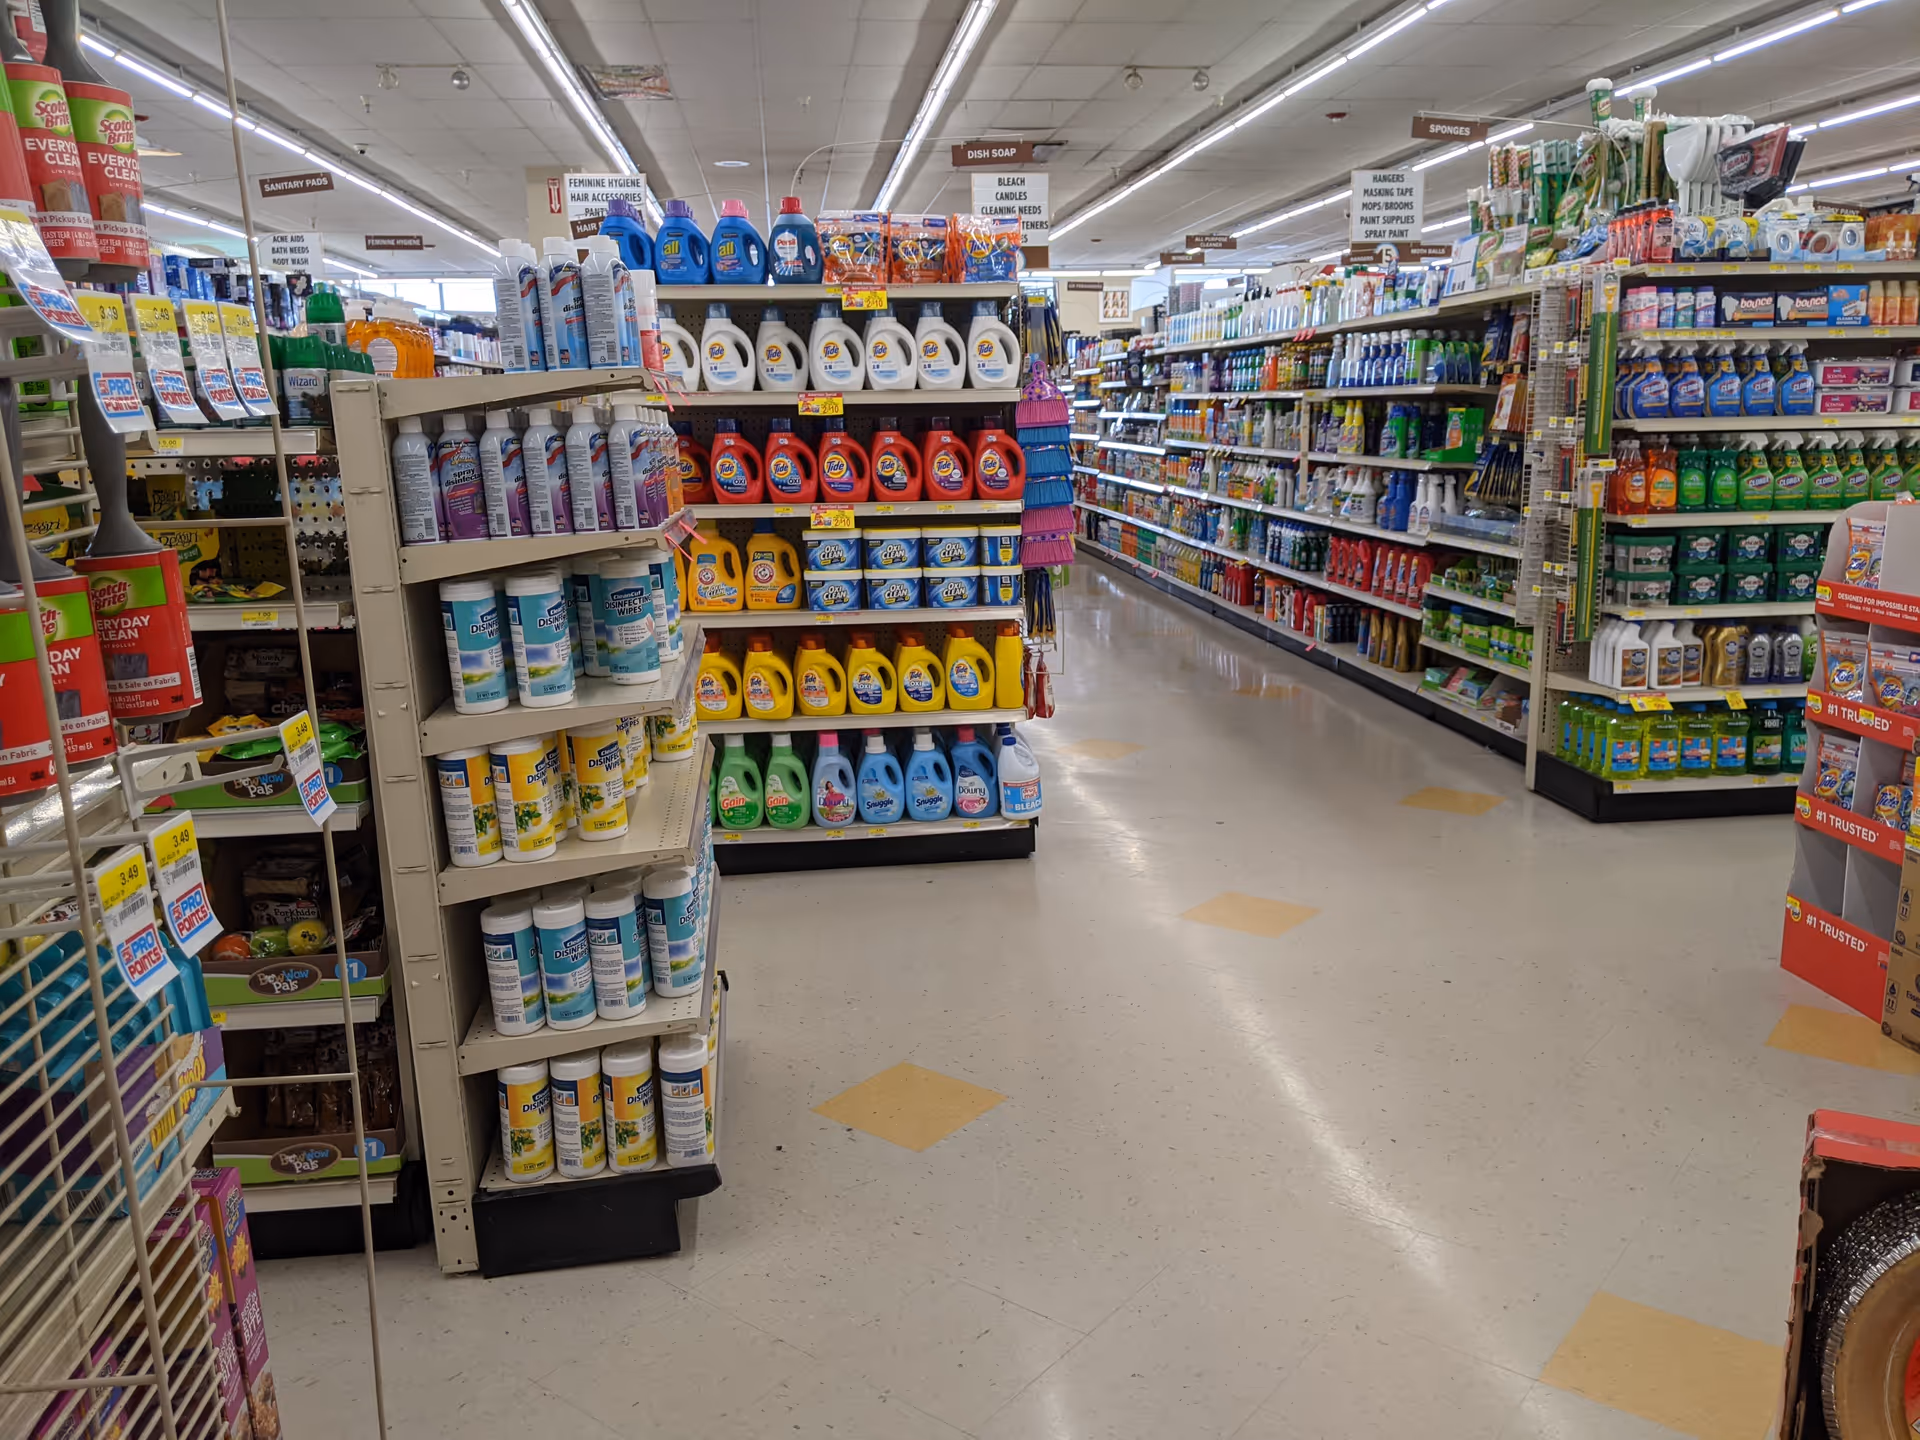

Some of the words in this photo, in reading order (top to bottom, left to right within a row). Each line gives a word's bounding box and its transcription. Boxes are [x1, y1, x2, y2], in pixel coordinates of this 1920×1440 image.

[1429, 123, 1470, 136] SPONGES
[967, 149, 988, 159] DISH
[991, 148, 1016, 158] SOAP
[264, 179, 303, 192] SANITARY
[305, 177, 328, 188] PADS
[569, 178, 606, 187] FEMININE
[608, 178, 640, 187] HYGIENE
[998, 178, 1025, 186] BLEACH
[1372, 174, 1404, 184] HANGERS
[571, 193, 589, 202] HAIR
[592, 193, 641, 202] ACCESSORIES
[996, 192, 1027, 200] CANDLES
[1363, 188, 1393, 198] MASKING
[1395, 187, 1414, 197] TAPE
[981, 206, 1016, 215] CLEANING
[1018, 206, 1042, 214] NEEDS
[1362, 200, 1414, 212] MOPS/BROOMS
[1022, 221, 1048, 230] TENERS
[1360, 216, 1380, 225] PAINT
[1382, 215, 1414, 225] SUPPLIES
[577, 223, 597, 233] HAIR
[273, 235, 288, 243] ACNE
[1365, 229, 1386, 239] SPRAY
[1388, 229, 1409, 238] PAINT
[663, 241, 679, 255] all
[777, 238, 796, 248] Persil
[718, 242, 734, 256] all
[1740, 296, 1772, 309] bounce
[1795, 296, 1827, 308] bounce
[708, 346, 724, 357] Tide
[822, 344, 840, 357] Tide
[872, 344, 888, 357] Tide
[922, 344, 939, 356] Tide
[977, 342, 994, 355] Tide
[765, 349, 782, 361] Tide
[288, 376, 318, 387] Wizard
[108, 379, 132, 396] PRO
[720, 463, 734, 473] Tide
[774, 463, 788, 473] Tide
[826, 461, 844, 473] Tide
[880, 461, 895, 471] Tide
[936, 460, 951, 471] Tide
[983, 458, 997, 469] Tide
[452, 468, 475, 478] spray
[1749, 476, 1770, 487] CLOROX
[1779, 476, 1802, 486] CLOROX
[1816, 476, 1838, 486] CLOROX
[821, 551, 843, 560] CLEAN
[882, 551, 904, 560] CLEAN
[941, 550, 963, 558] CLEAN
[614, 590, 641, 599] CleanCut
[824, 591, 846, 600] CLEAN
[885, 590, 908, 599] CLEAN
[943, 589, 965, 597] CLEAN
[1838, 592, 1862, 604] DESIGNED
[1863, 597, 1875, 606] FOR
[1876, 599, 1906, 611] IMPOSSIBLE
[618, 605, 642, 616] WIPES
[97, 615, 150, 630] ERYDAY
[125, 680, 140, 689] Safe
[155, 676, 176, 686] Fabric
[1881, 683, 1900, 698] Tide
[87, 716, 106, 726] Fabric
[1828, 703, 1838, 717] #1
[1841, 706, 1890, 732] TRUED
[295, 722, 307, 738] 3.49
[103, 736, 112, 745] 3M
[10, 748, 38, 760] Fabric
[30, 769, 45, 781] 3M
[309, 774, 323, 793] PRO
[1821, 774, 1836, 789] Tide
[248, 784, 273, 797] Pals
[958, 786, 986, 796] Downy
[1023, 787, 1037, 795] drug
[722, 796, 745, 809] Gain
[767, 796, 788, 807] Gain
[866, 798, 893, 810] Snuggle
[916, 795, 942, 806] Snuggle
[1877, 792, 1899, 809] Tide
[1816, 811, 1827, 824] #1
[172, 829, 189, 848] 3.49
[120, 864, 139, 885] 3.49
[182, 889, 202, 915] PRO
[1806, 914, 1817, 928] #1
[131, 930, 154, 959] PRO
[273, 980, 298, 993] Pals
[294, 1159, 318, 1173] Pals
